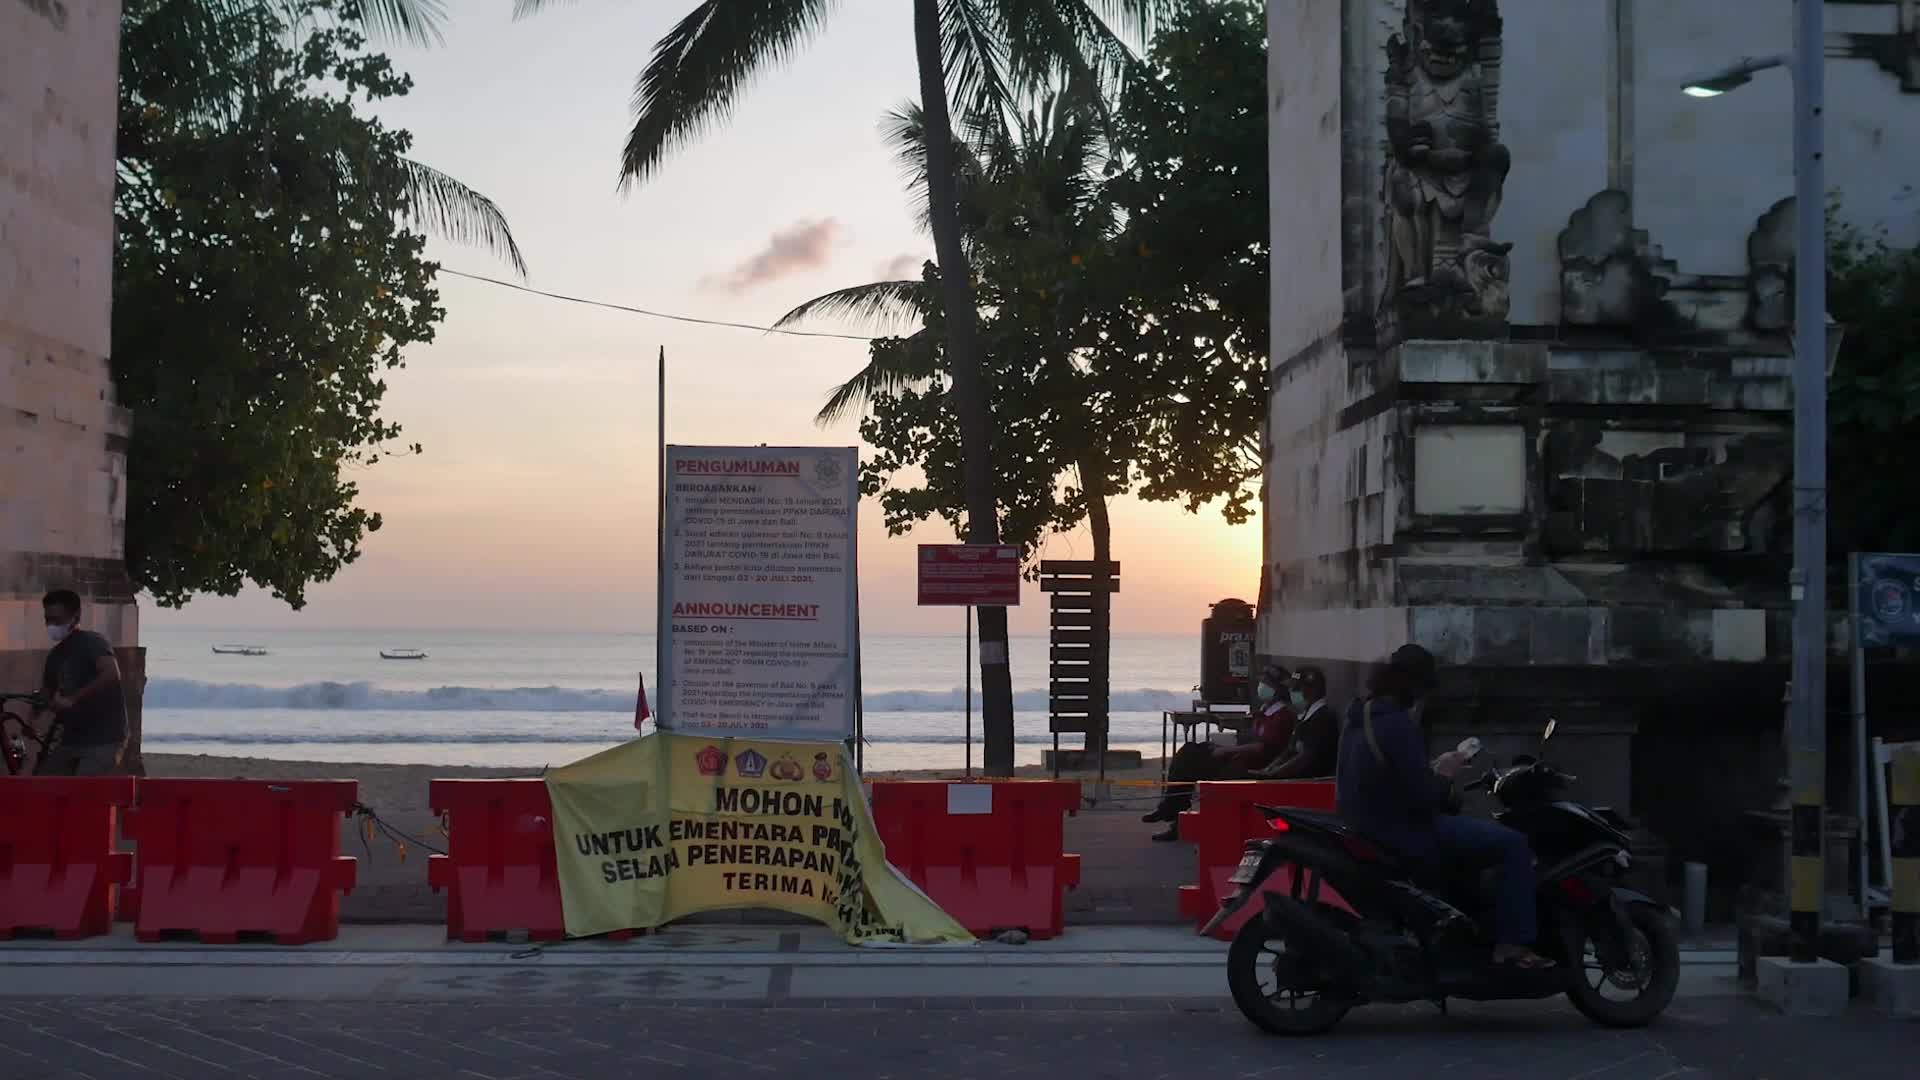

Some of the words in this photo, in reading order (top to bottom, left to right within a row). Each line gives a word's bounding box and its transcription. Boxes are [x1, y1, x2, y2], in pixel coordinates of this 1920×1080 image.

[675, 459, 800, 473] PENGUMUMAN
[672, 602, 820, 617] ANNOUNCEMENT
[672, 624, 707, 634] BASED
[710, 625, 726, 634] ON
[731, 720, 750, 728] JULY
[715, 787, 823, 818] MOHON
[575, 825, 663, 857] UNTUK
[669, 819, 804, 845] EMENTARA
[687, 845, 835, 877] PENERAPAN
[723, 872, 814, 898] TERIMA
